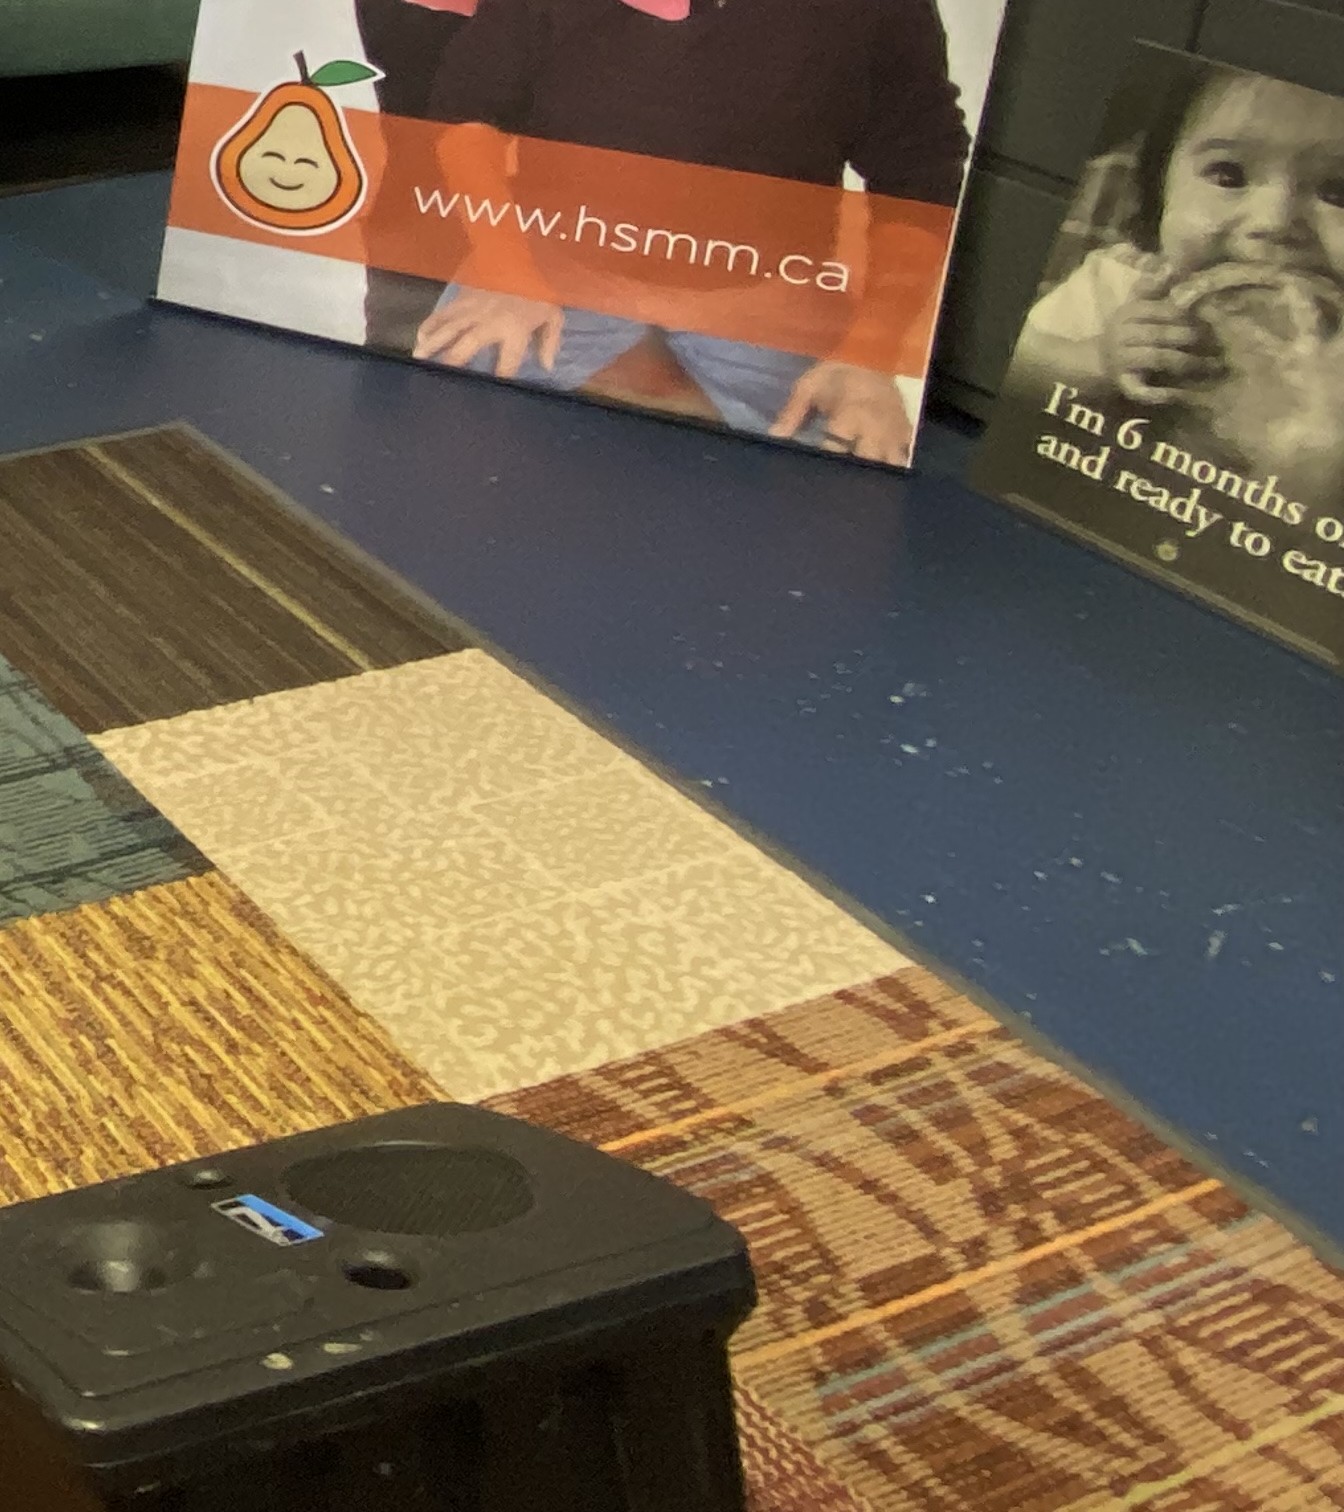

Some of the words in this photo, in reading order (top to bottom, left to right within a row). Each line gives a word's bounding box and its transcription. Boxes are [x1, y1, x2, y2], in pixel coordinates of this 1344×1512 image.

[413, 184, 850, 294] www.hsmm.ca
[1036, 433, 1111, 481] and
[1113, 470, 1224, 539] ready
[1228, 519, 1272, 558] to
[1116, 417, 1152, 451] 6
[1150, 441, 1309, 526] months
